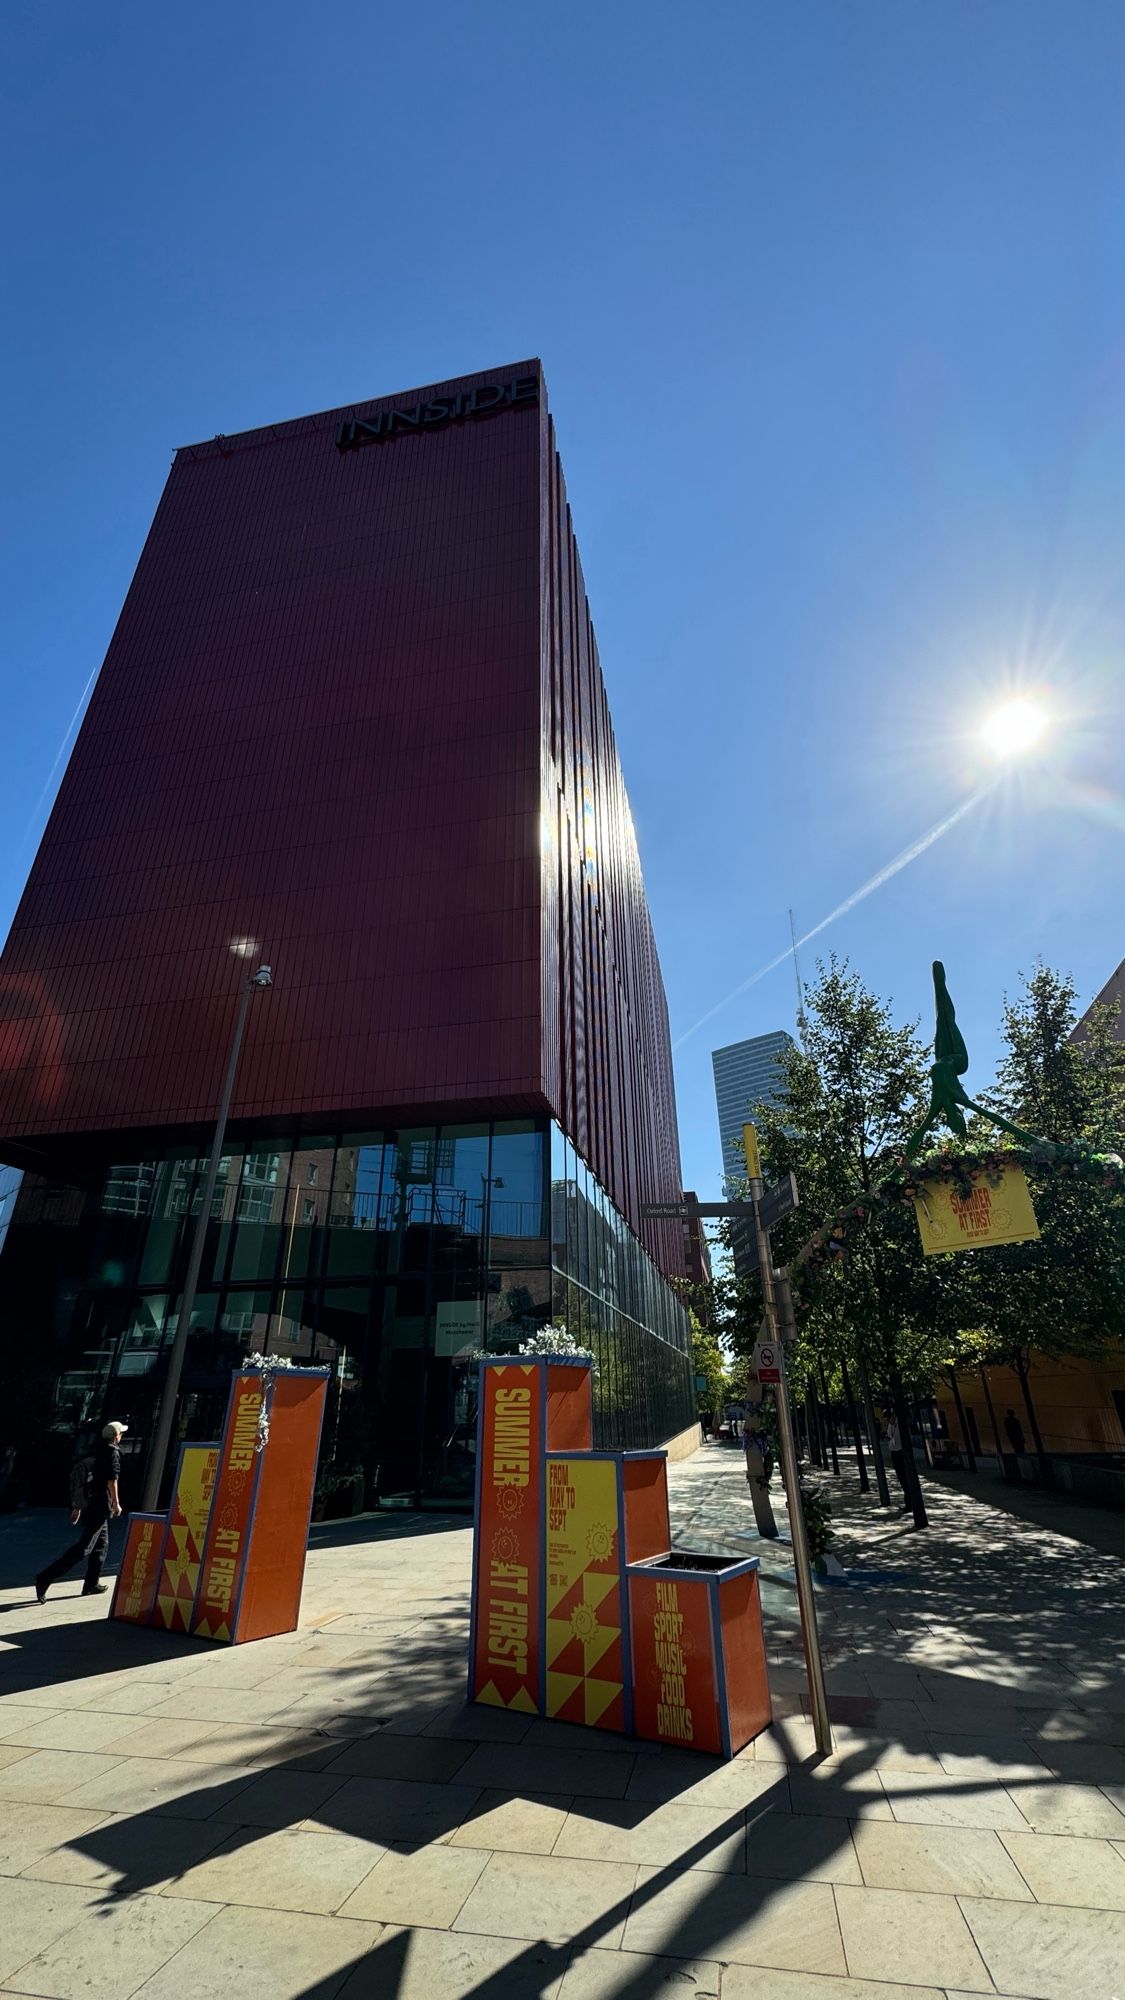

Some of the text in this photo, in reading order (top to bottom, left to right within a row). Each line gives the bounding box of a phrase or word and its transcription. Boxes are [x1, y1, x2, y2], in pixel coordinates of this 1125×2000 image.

[958, 1208, 992, 1231] AT FIRST
[549, 1463, 569, 1487] FROM
[205, 1393, 262, 1613] SUMMER AT FIRST
[549, 1486, 576, 1510] MAY TO
[488, 1388, 531, 1675] SUMMER AT FIRST
[549, 1508, 568, 1532] SEPT
[655, 1582, 679, 1612] FILM
[653, 1611, 684, 1642] SPORT
[655, 1640, 687, 1675] MUSIC
[660, 1674, 686, 1706] FOOD
[656, 1703, 694, 1741] DRINKS
